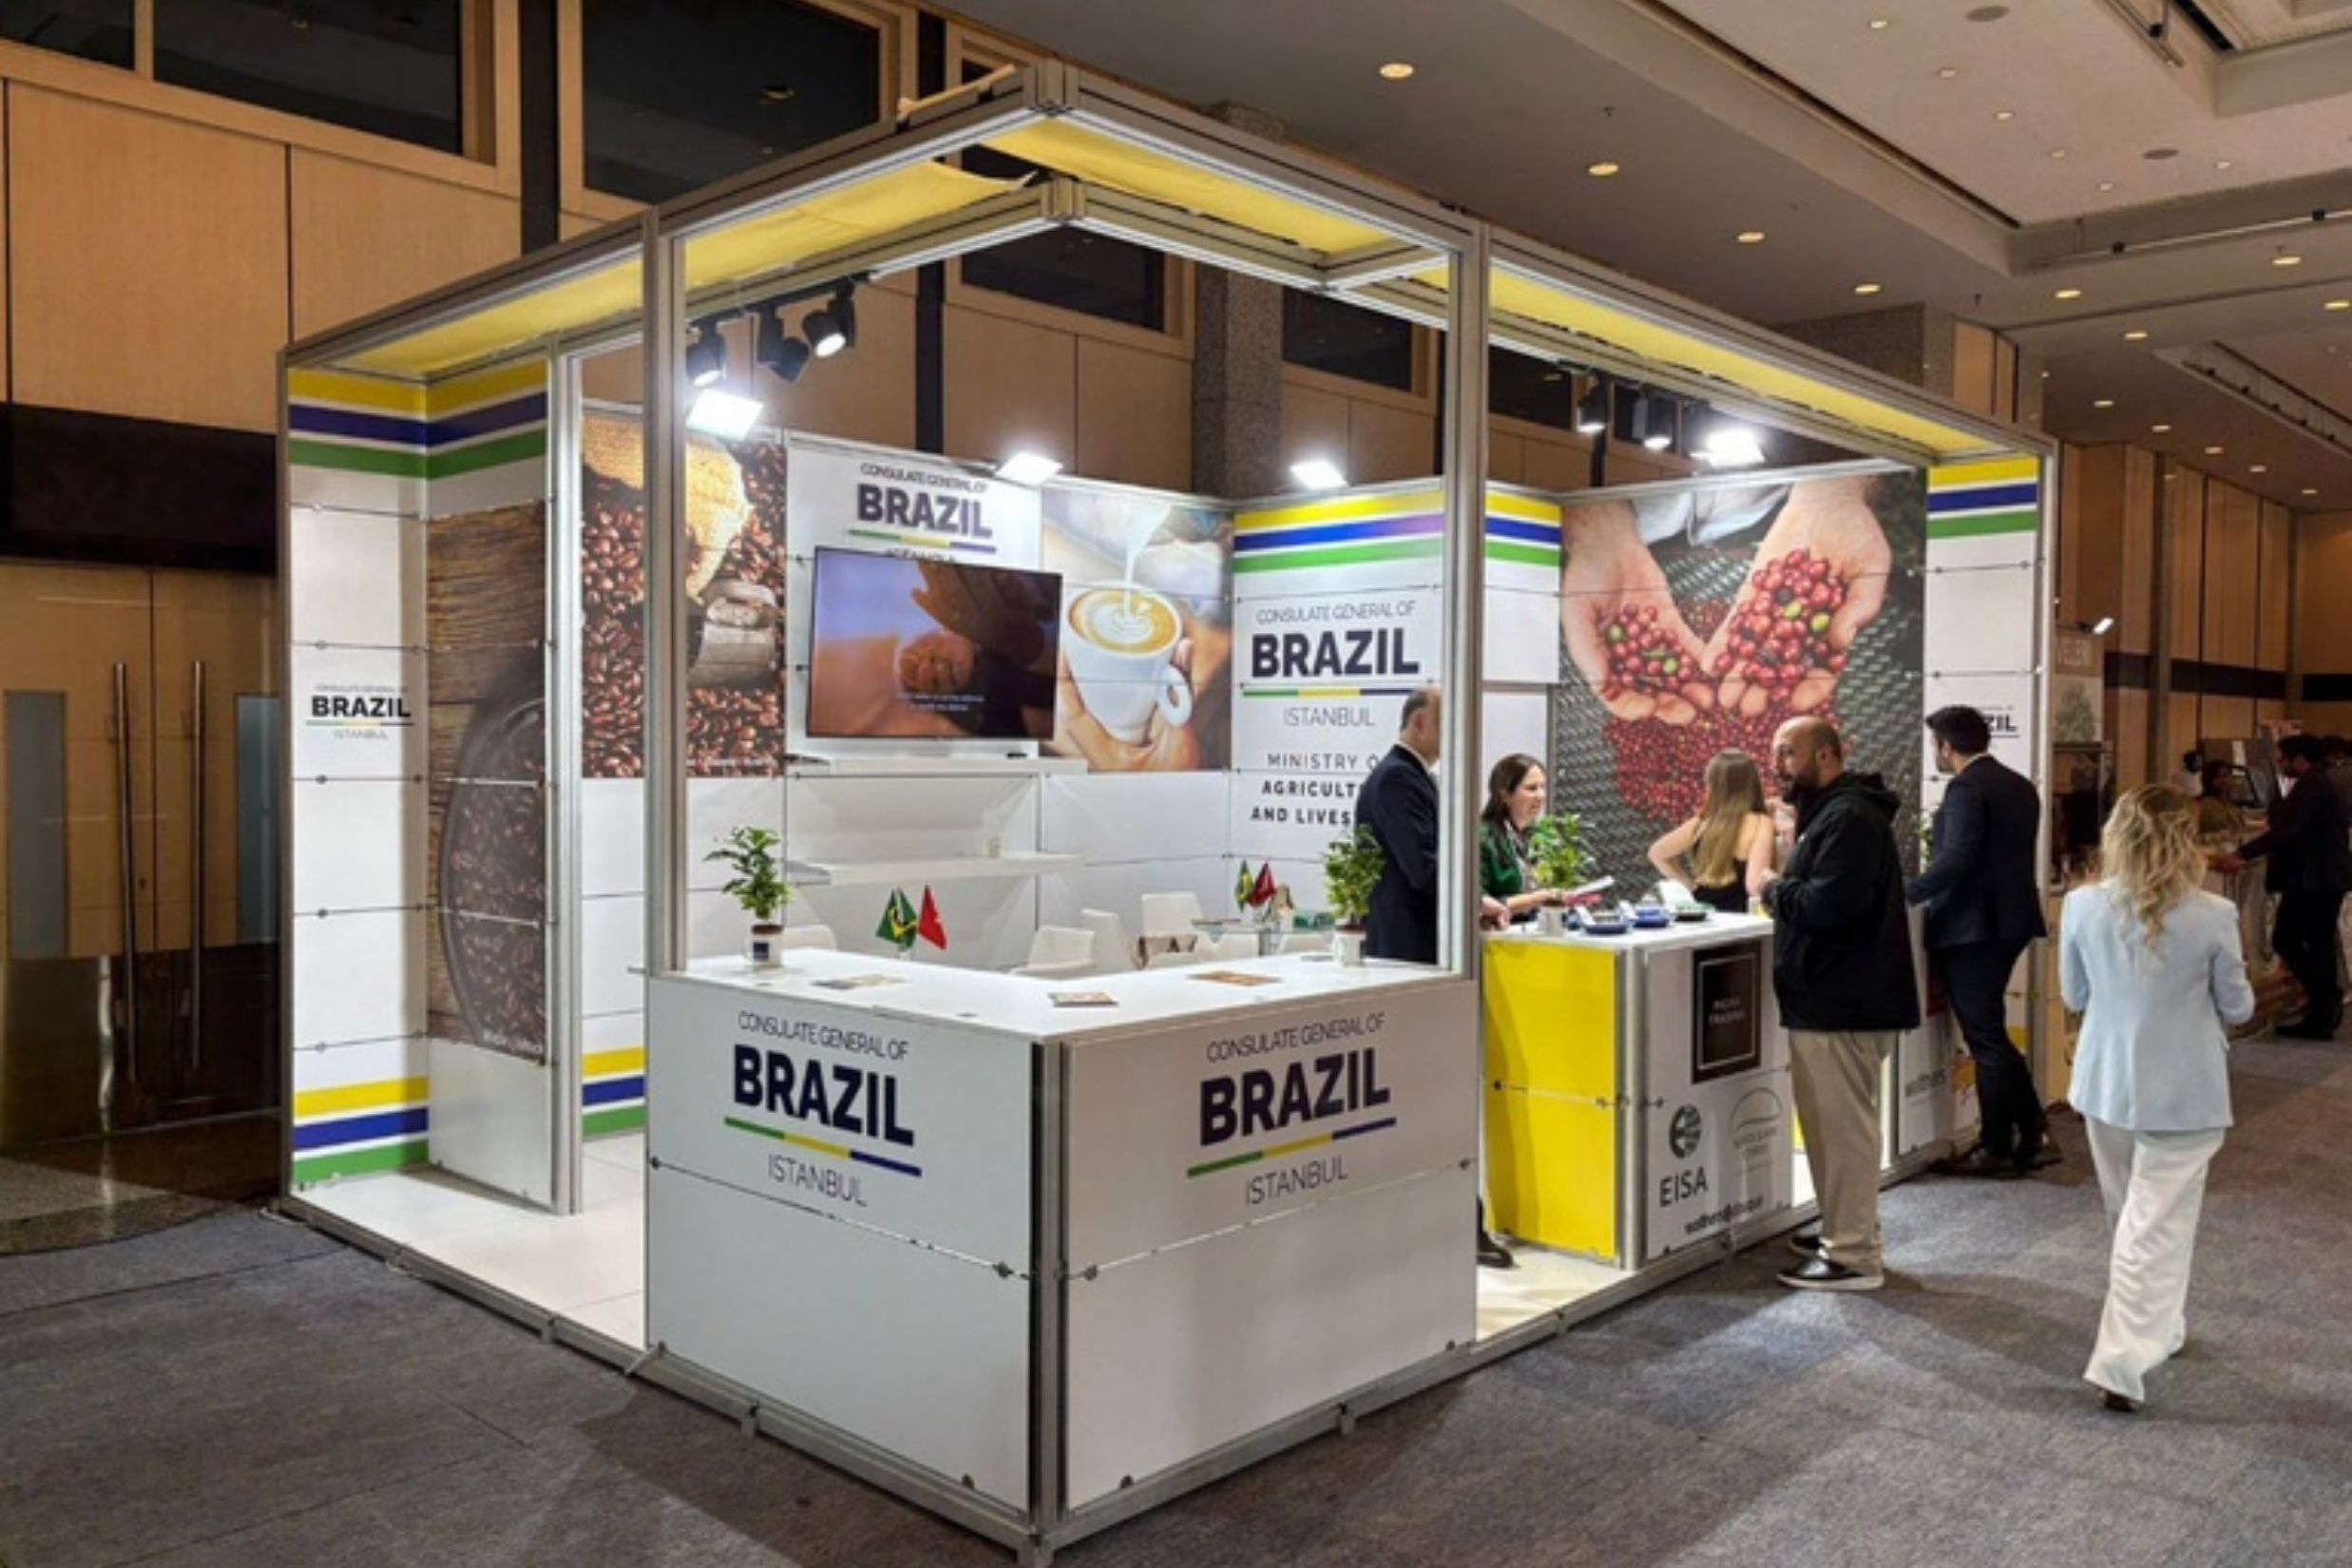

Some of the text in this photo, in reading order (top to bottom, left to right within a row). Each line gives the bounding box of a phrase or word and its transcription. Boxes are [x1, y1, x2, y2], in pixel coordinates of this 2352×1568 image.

[857, 483, 993, 539] BRAZIL
[1256, 600, 1415, 625] CONSULATE GENERAL OF
[1252, 627, 1420, 678] BRAZIL
[312, 695, 411, 717] BRAZIL
[1285, 707, 1375, 727] ISTANBUL
[1267, 752, 1357, 770] MINISTRY
[1261, 780, 1356, 797] AGRICULT
[1251, 806, 1351, 827] AND LIVES
[738, 1010, 909, 1061] CONSULATE GENERAL OF
[1206, 1011, 1386, 1062] CONSULATE GENERAL OF
[735, 1043, 914, 1147] BRAZIL
[1200, 1047, 1391, 1147] BRAZIL
[768, 1154, 868, 1208] ISTANBUL
[1246, 1155, 1348, 1206] ISTANBUL
[1659, 1165, 1709, 1208] EISA
